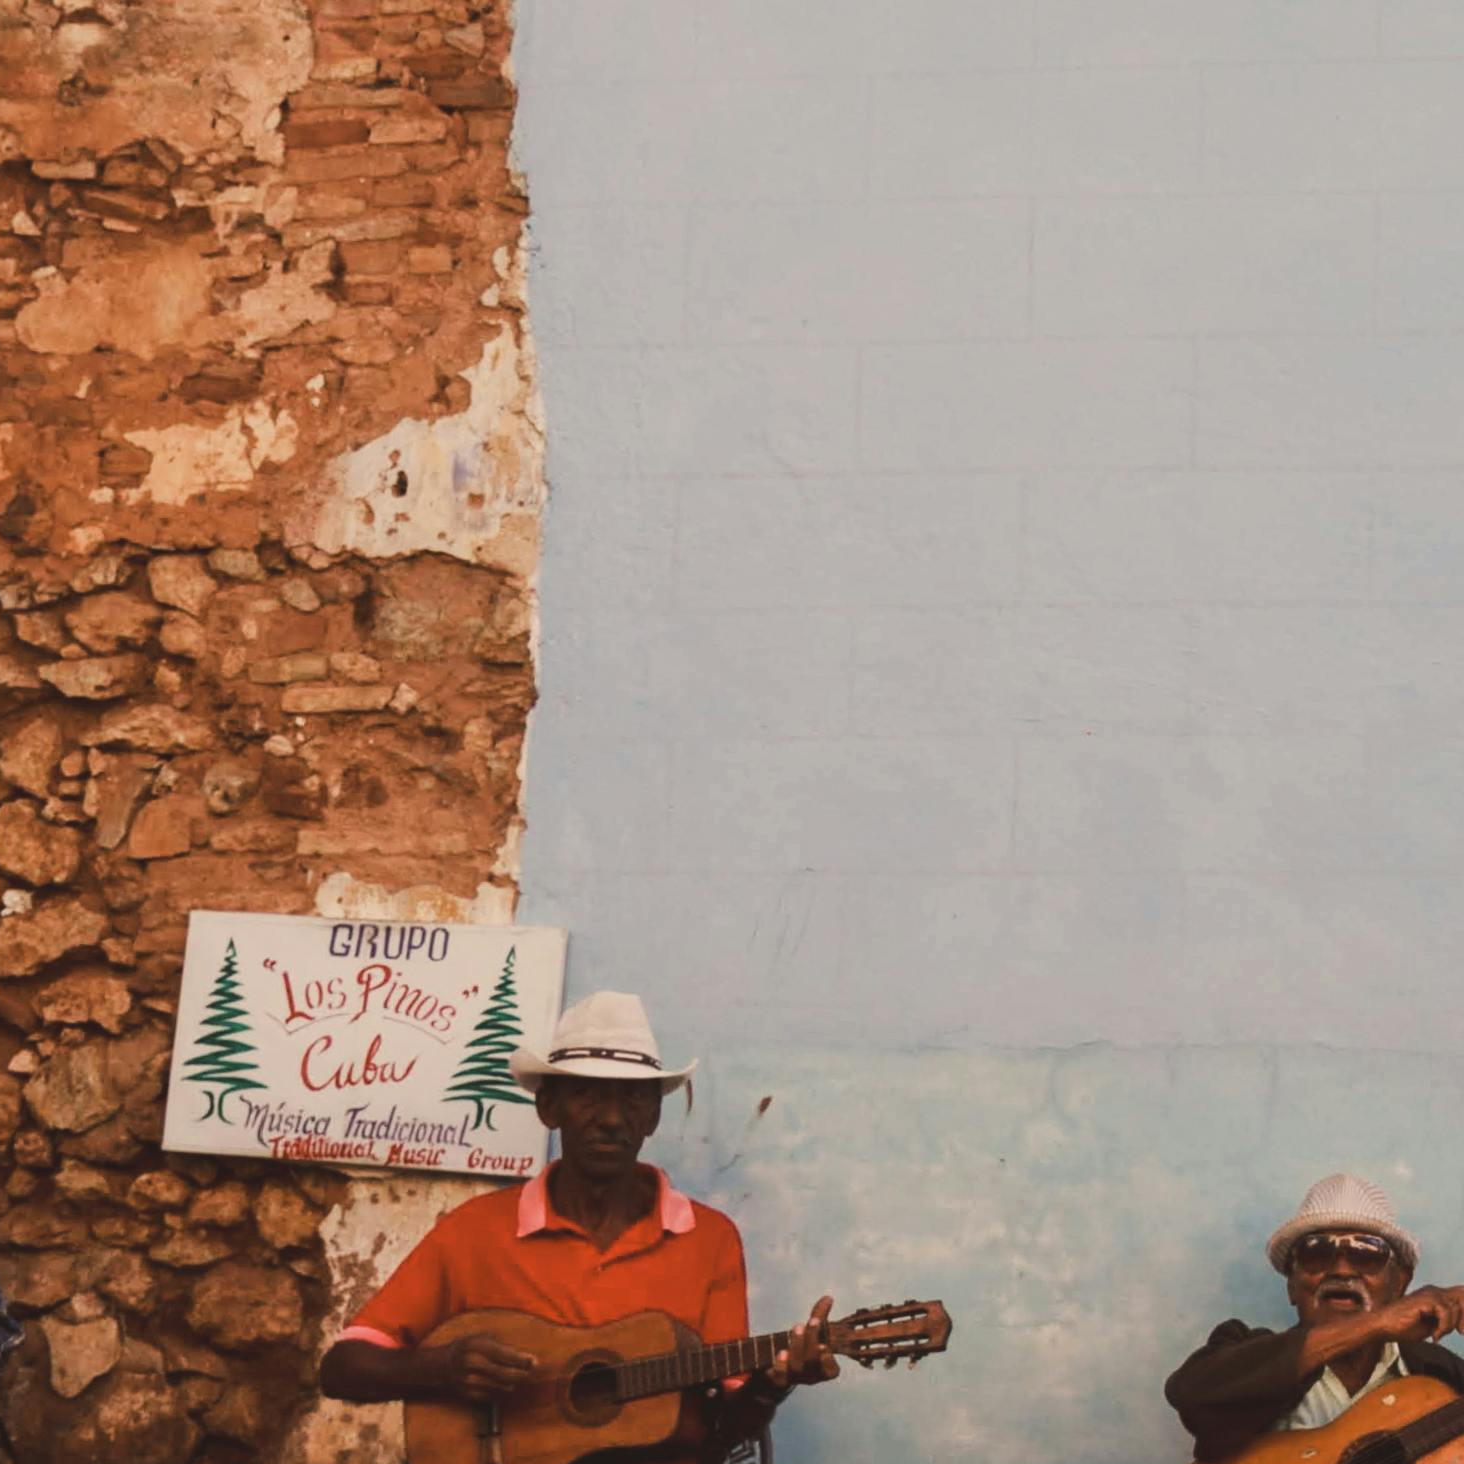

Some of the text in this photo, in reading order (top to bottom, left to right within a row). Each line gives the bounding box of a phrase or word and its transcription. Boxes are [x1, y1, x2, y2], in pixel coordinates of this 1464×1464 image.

[329, 923, 450, 962] GRUPO
[300, 1034, 417, 1092] Cuba
[239, 1095, 472, 1148] Música Tradicional
[385, 1143, 446, 1167] Music
[467, 1148, 534, 1175] Group
